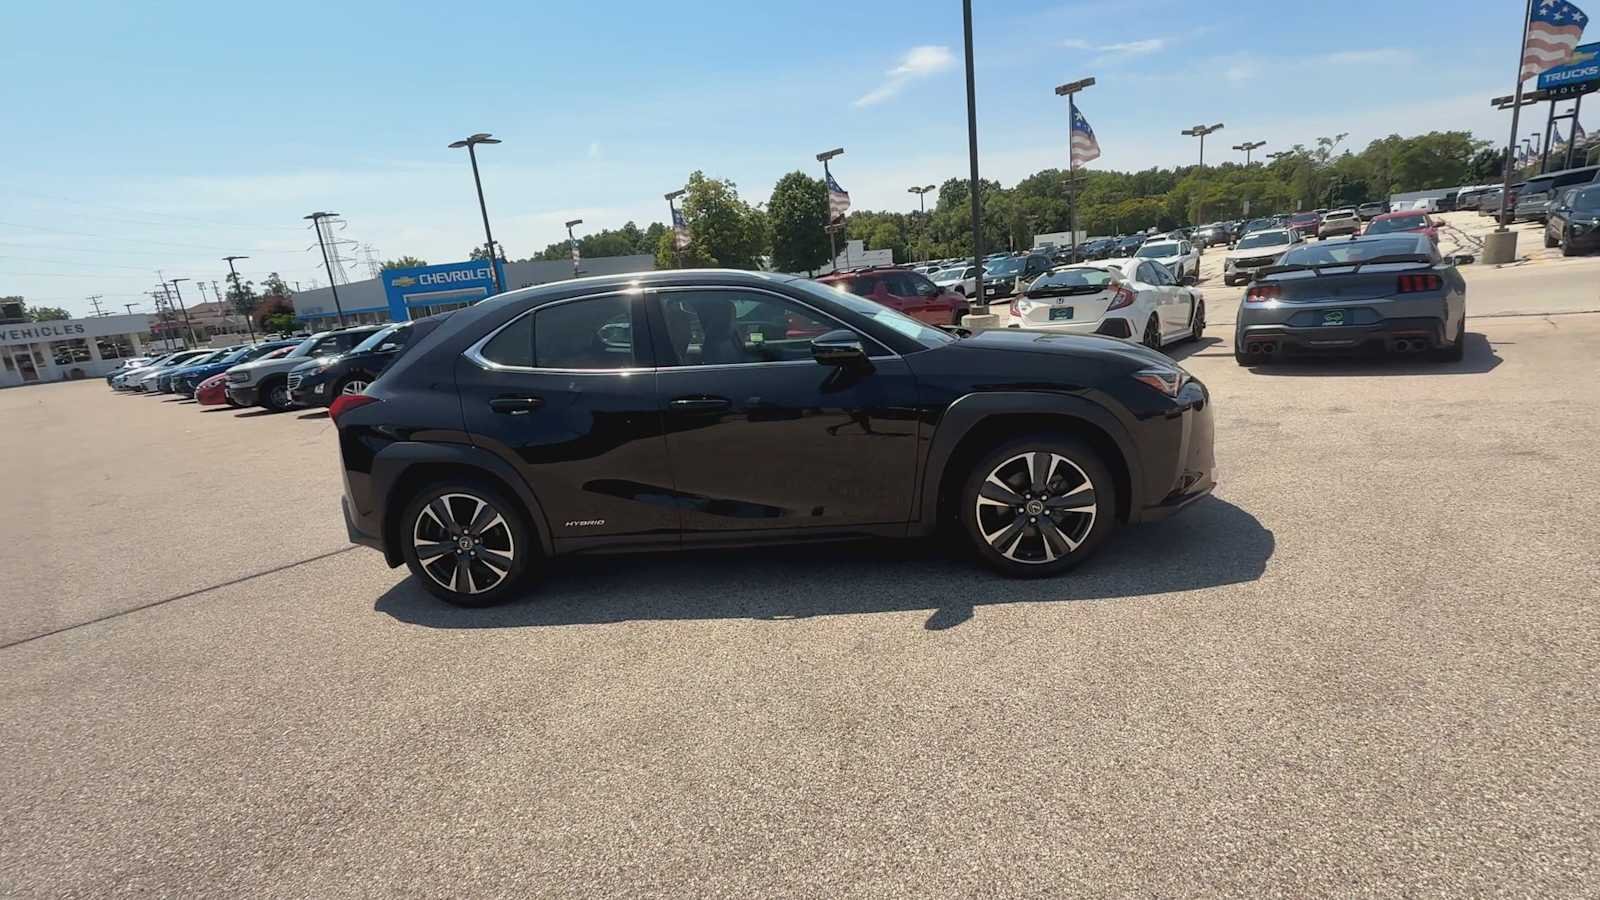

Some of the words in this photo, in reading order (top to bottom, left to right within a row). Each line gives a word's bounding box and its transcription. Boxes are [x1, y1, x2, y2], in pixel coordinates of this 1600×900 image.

[1544, 66, 1599, 82] TRUCKS
[420, 268, 491, 285] CHEVROLET
[0, 324, 85, 341] VEHICLES
[565, 519, 605, 527] HYBRID
